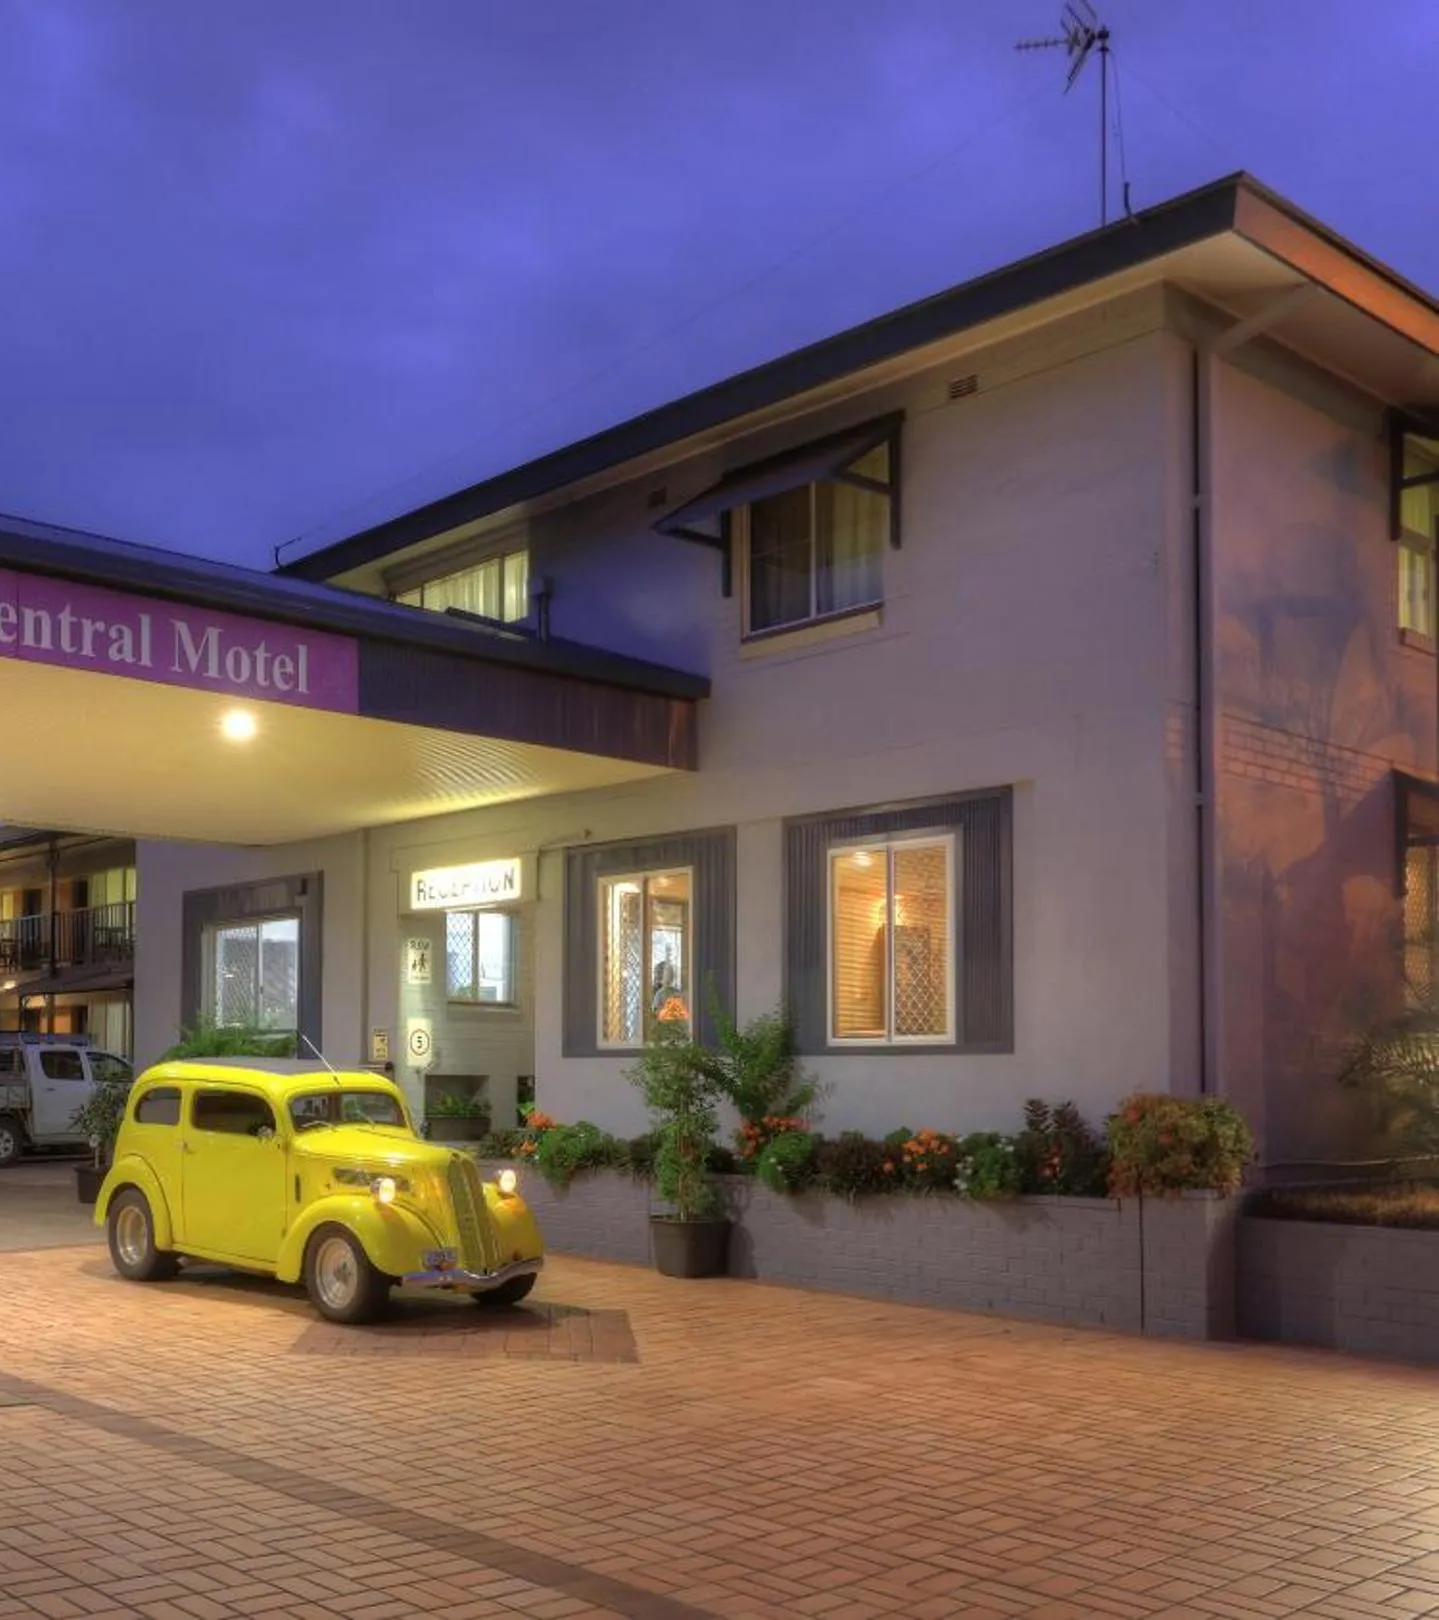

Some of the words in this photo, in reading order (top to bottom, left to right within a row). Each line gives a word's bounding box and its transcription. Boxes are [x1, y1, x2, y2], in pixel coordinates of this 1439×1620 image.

[171, 619, 309, 694] Motel
[416, 867, 515, 902] RECEPION
[415, 1034, 424, 1050] 5
